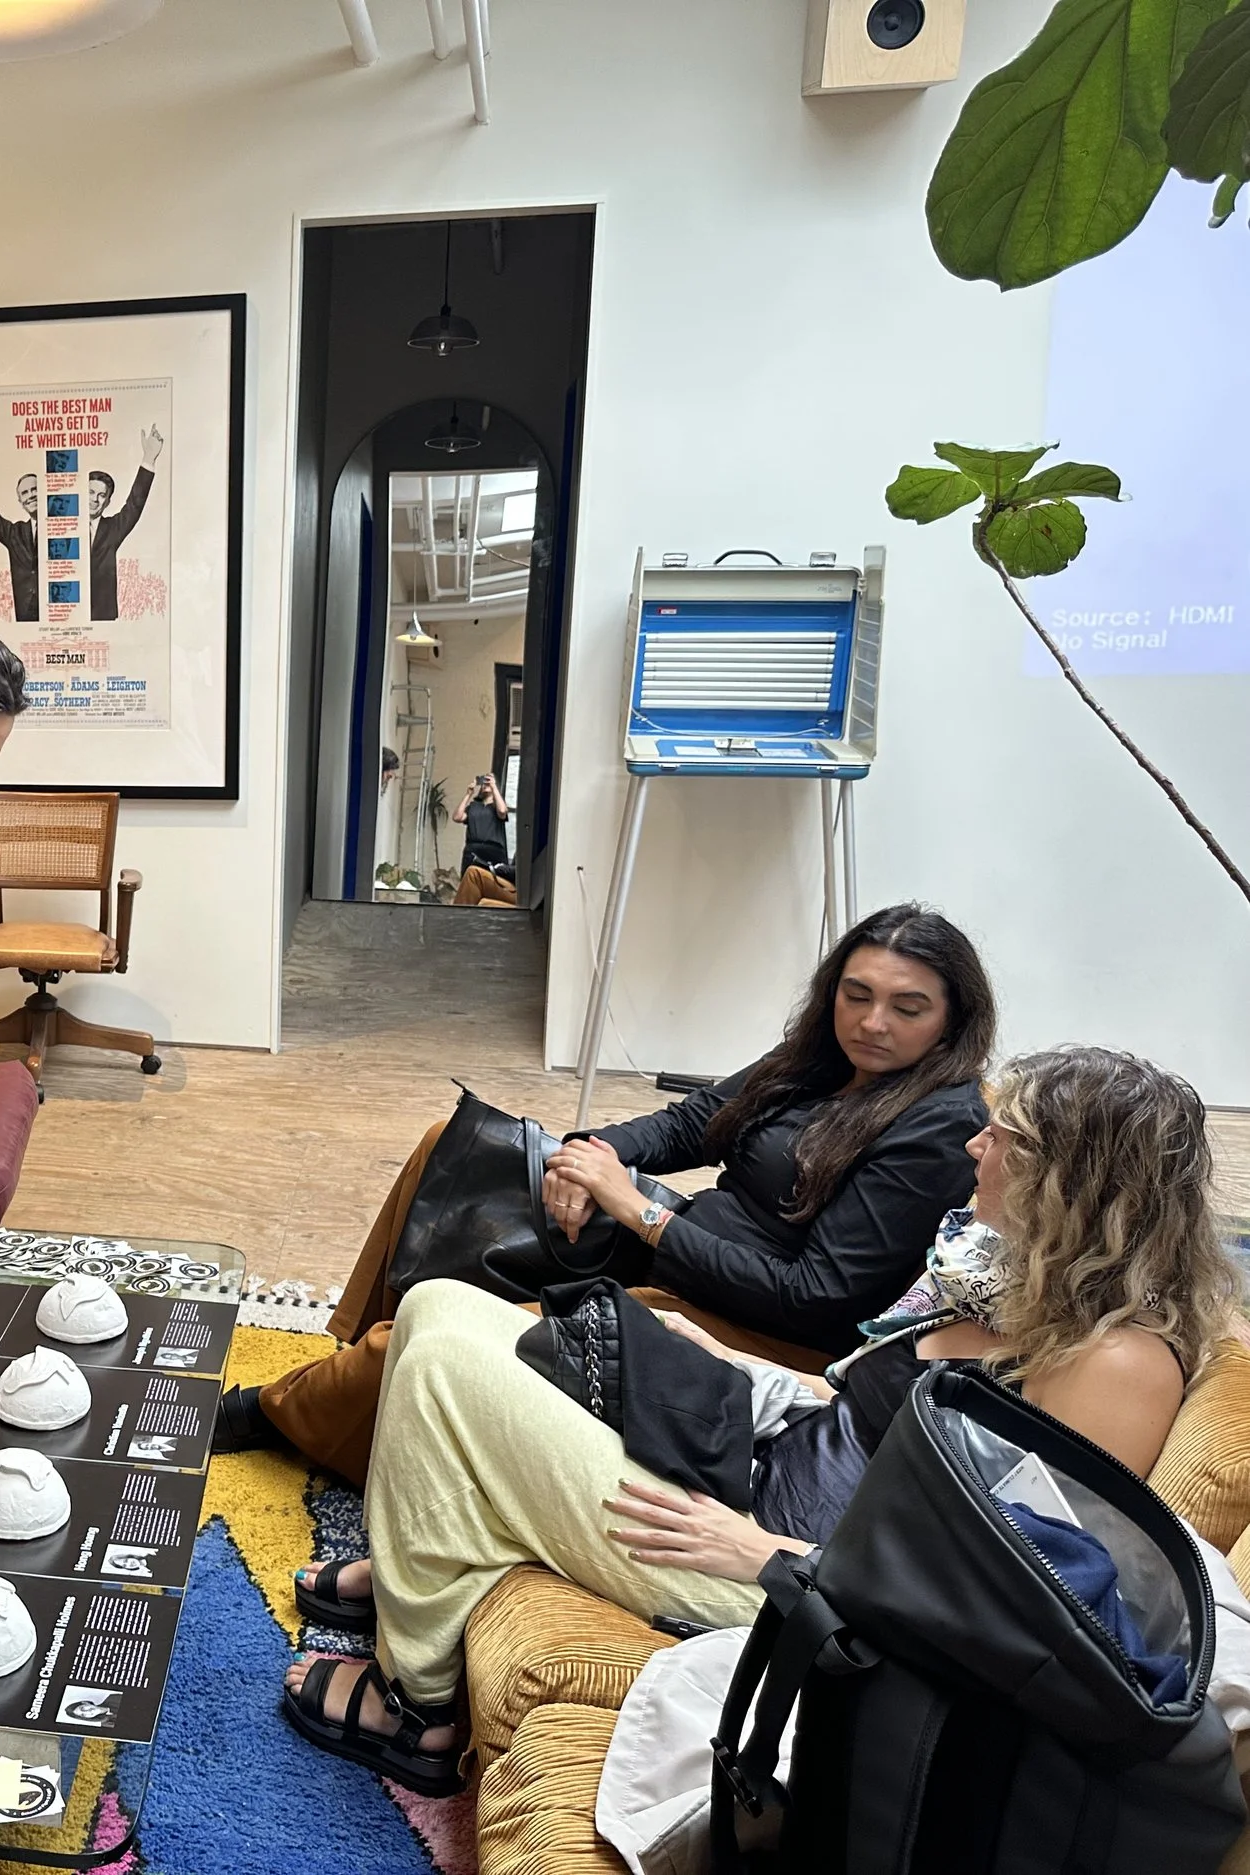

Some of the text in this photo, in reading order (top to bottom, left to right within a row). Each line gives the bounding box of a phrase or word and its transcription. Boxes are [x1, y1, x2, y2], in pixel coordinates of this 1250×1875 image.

[12, 398, 112, 416] DOES THE BEST MAN
[25, 415, 99, 432] ALWAYS GET TO
[15, 432, 109, 449] THE WHITE HOUSE?
[1052, 605, 1235, 627] Source: HDMI
[1091, 629, 1167, 652] Signal
[46, 654, 86, 664] BEST MAN
[23, 680, 147, 691] OBERTSON ADAMS LEIGHTON
[54, 697, 91, 707] SOTHERN
[73, 1527, 100, 1571] Hong Hoang
[25, 1679, 50, 1720] Sameera
[55, 1596, 76, 1628] Holmes
